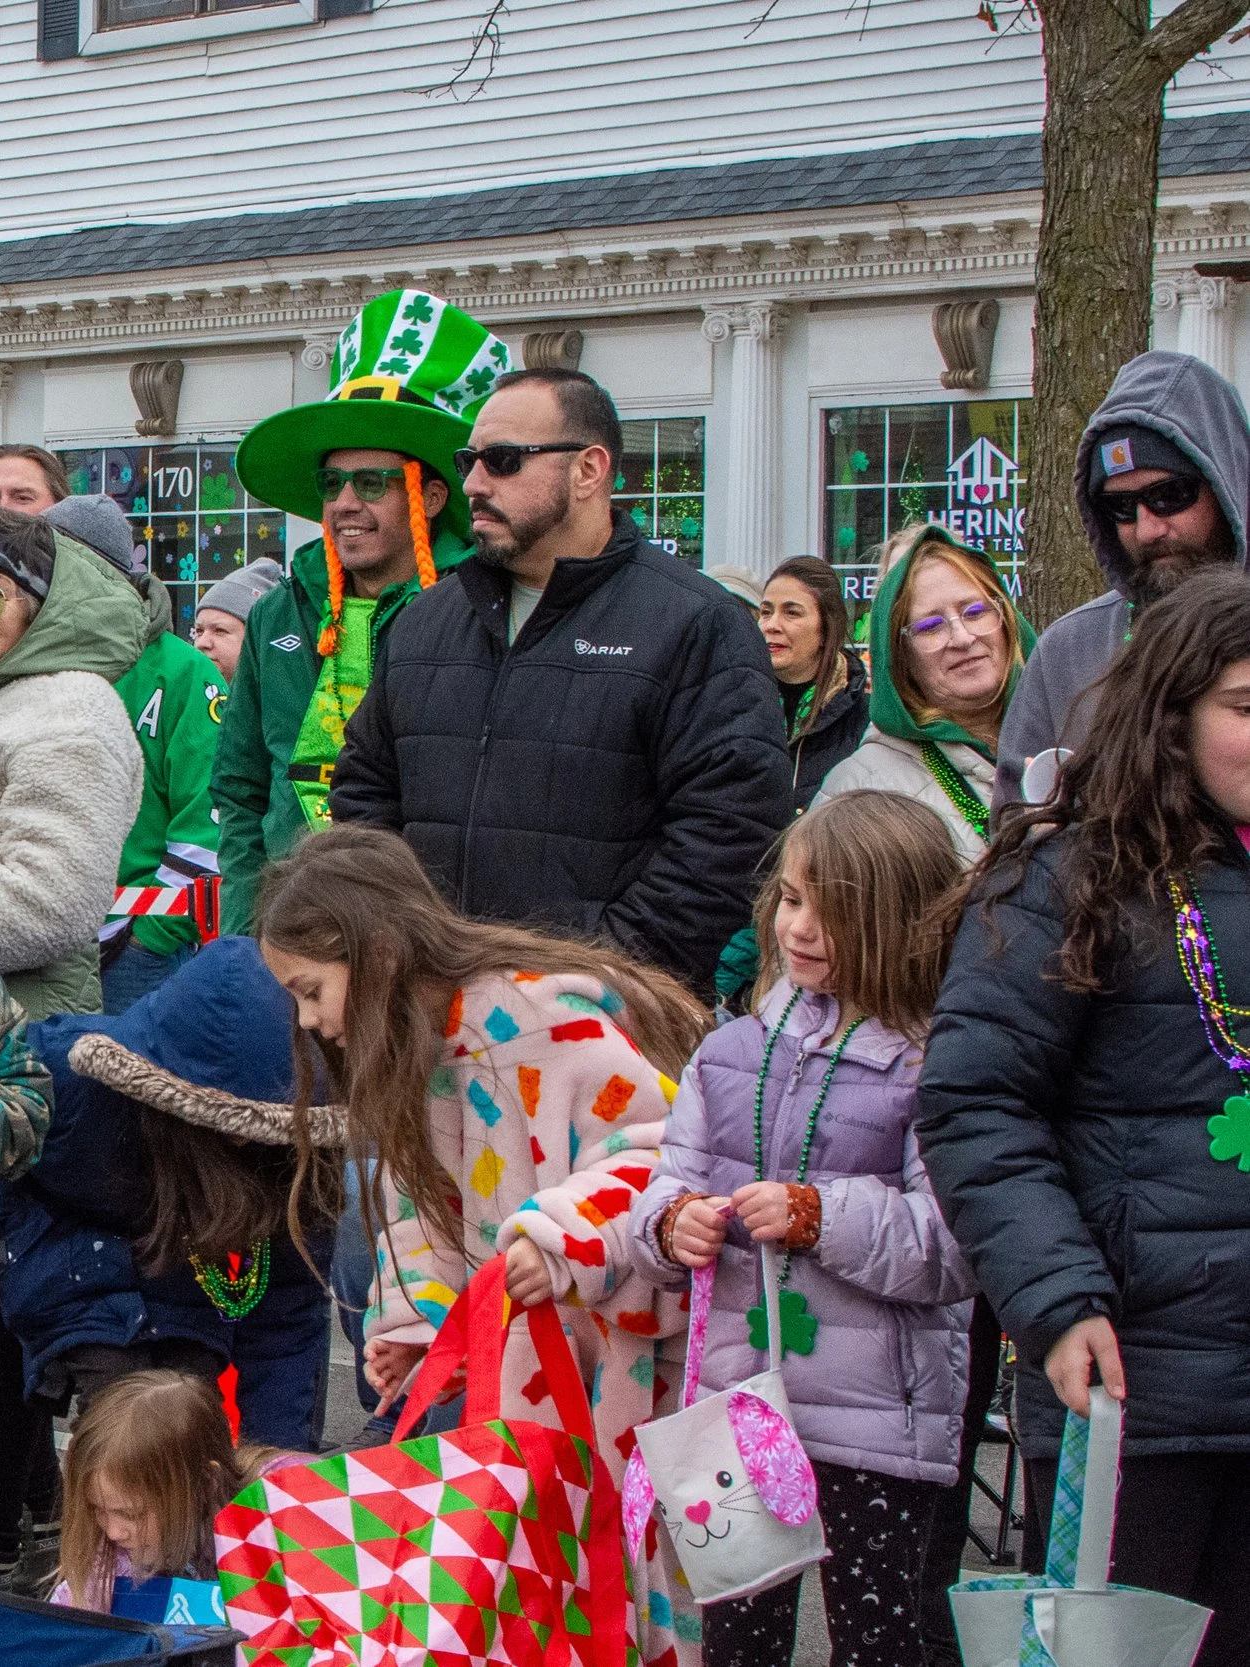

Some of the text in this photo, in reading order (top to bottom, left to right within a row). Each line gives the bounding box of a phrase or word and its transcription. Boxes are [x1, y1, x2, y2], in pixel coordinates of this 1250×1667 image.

[153, 466, 193, 498] 170
[993, 538, 1025, 552] TEA
[588, 646, 633, 656] ARIAT
[136, 688, 164, 738] A
